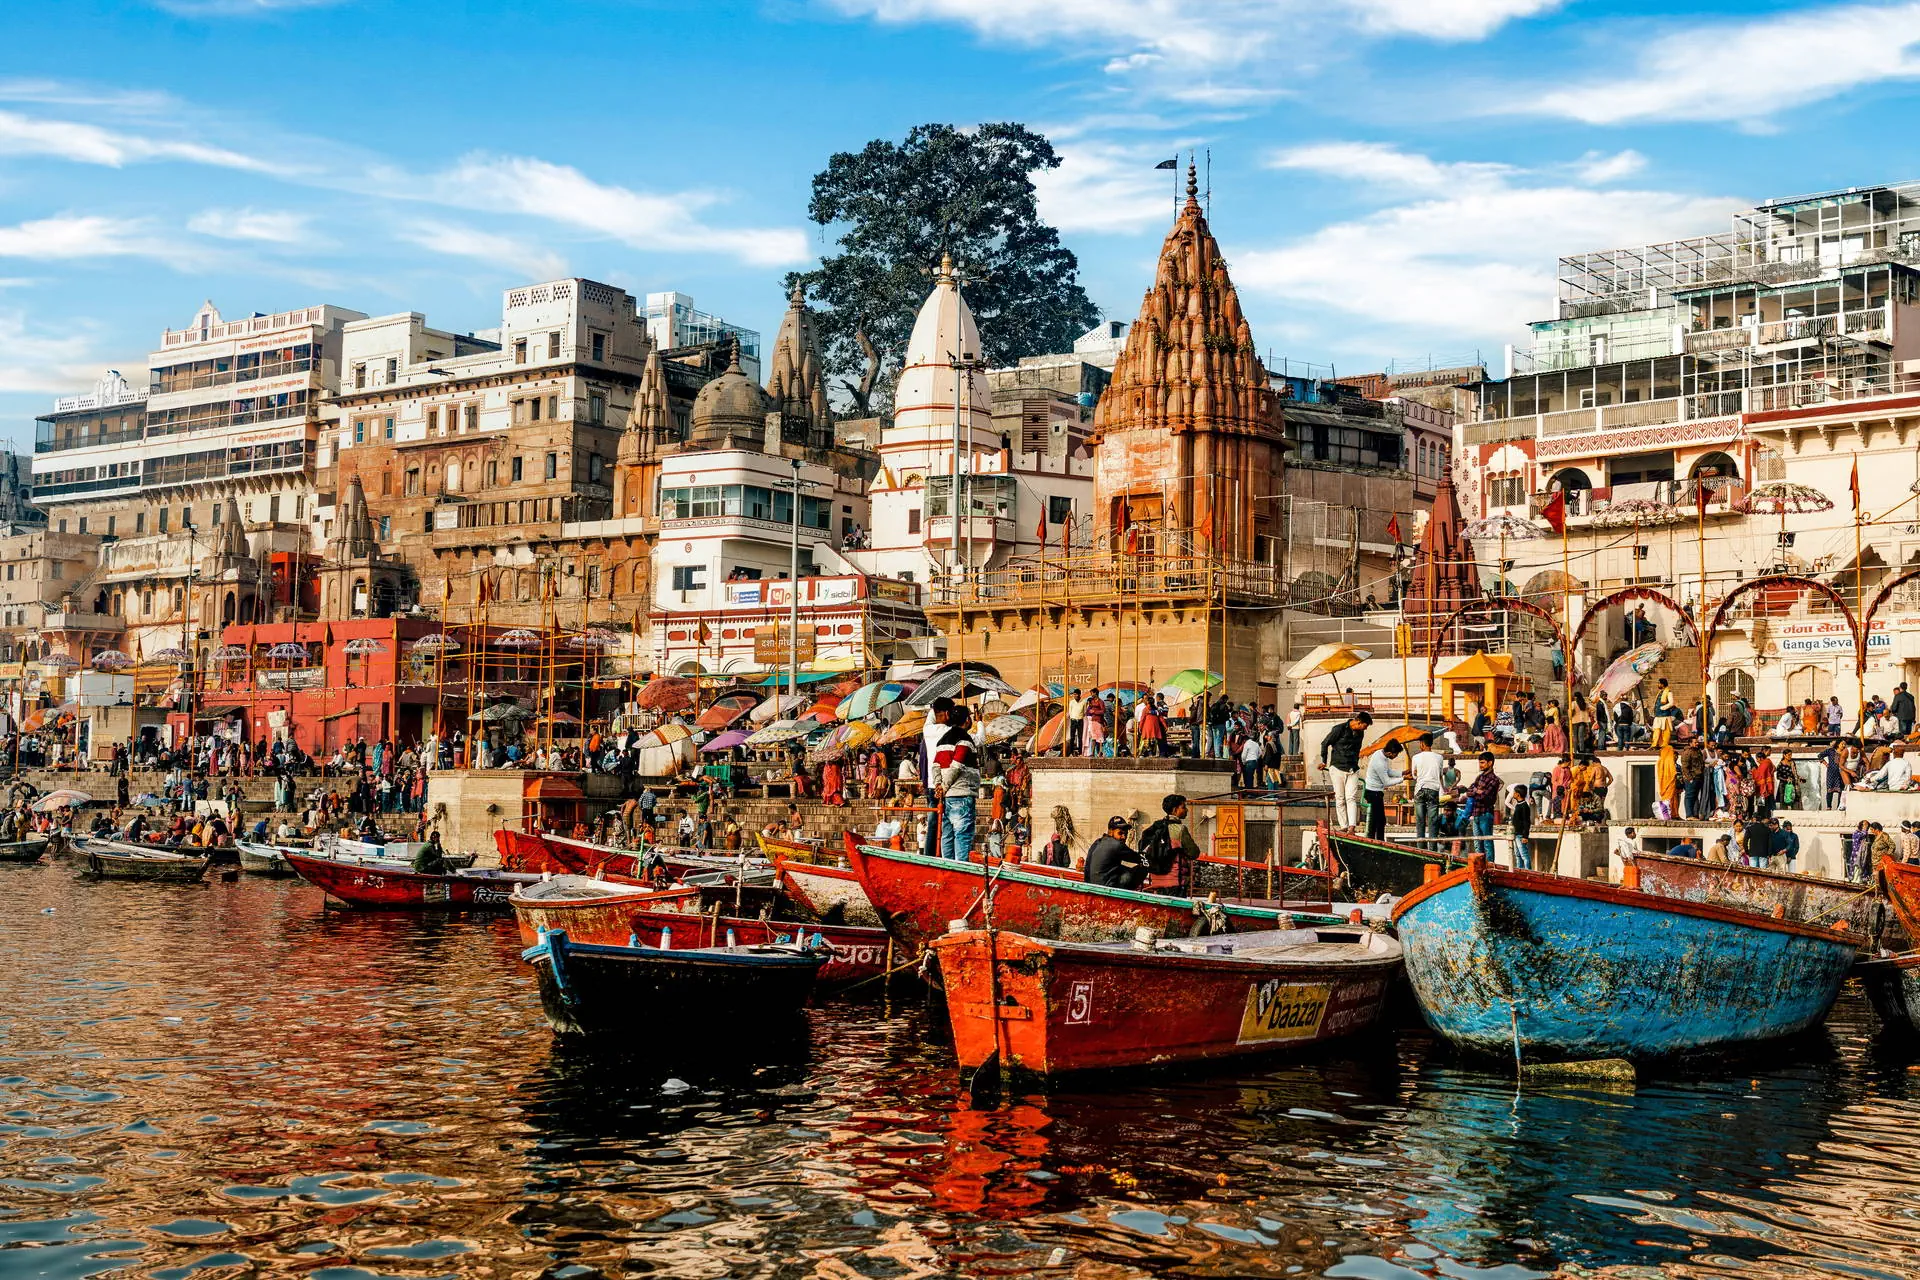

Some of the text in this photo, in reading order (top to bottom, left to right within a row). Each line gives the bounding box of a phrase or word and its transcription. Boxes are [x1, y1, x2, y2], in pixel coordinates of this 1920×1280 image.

[830, 590, 851, 598] sidbi
[1783, 624, 1813, 634] गंगा
[1817, 622, 1845, 633] सेवा
[1782, 639, 1820, 651] Ganga
[1822, 637, 1853, 649] Seva
[1071, 984, 1090, 1020] 5
[1267, 997, 1324, 1030] baazar
